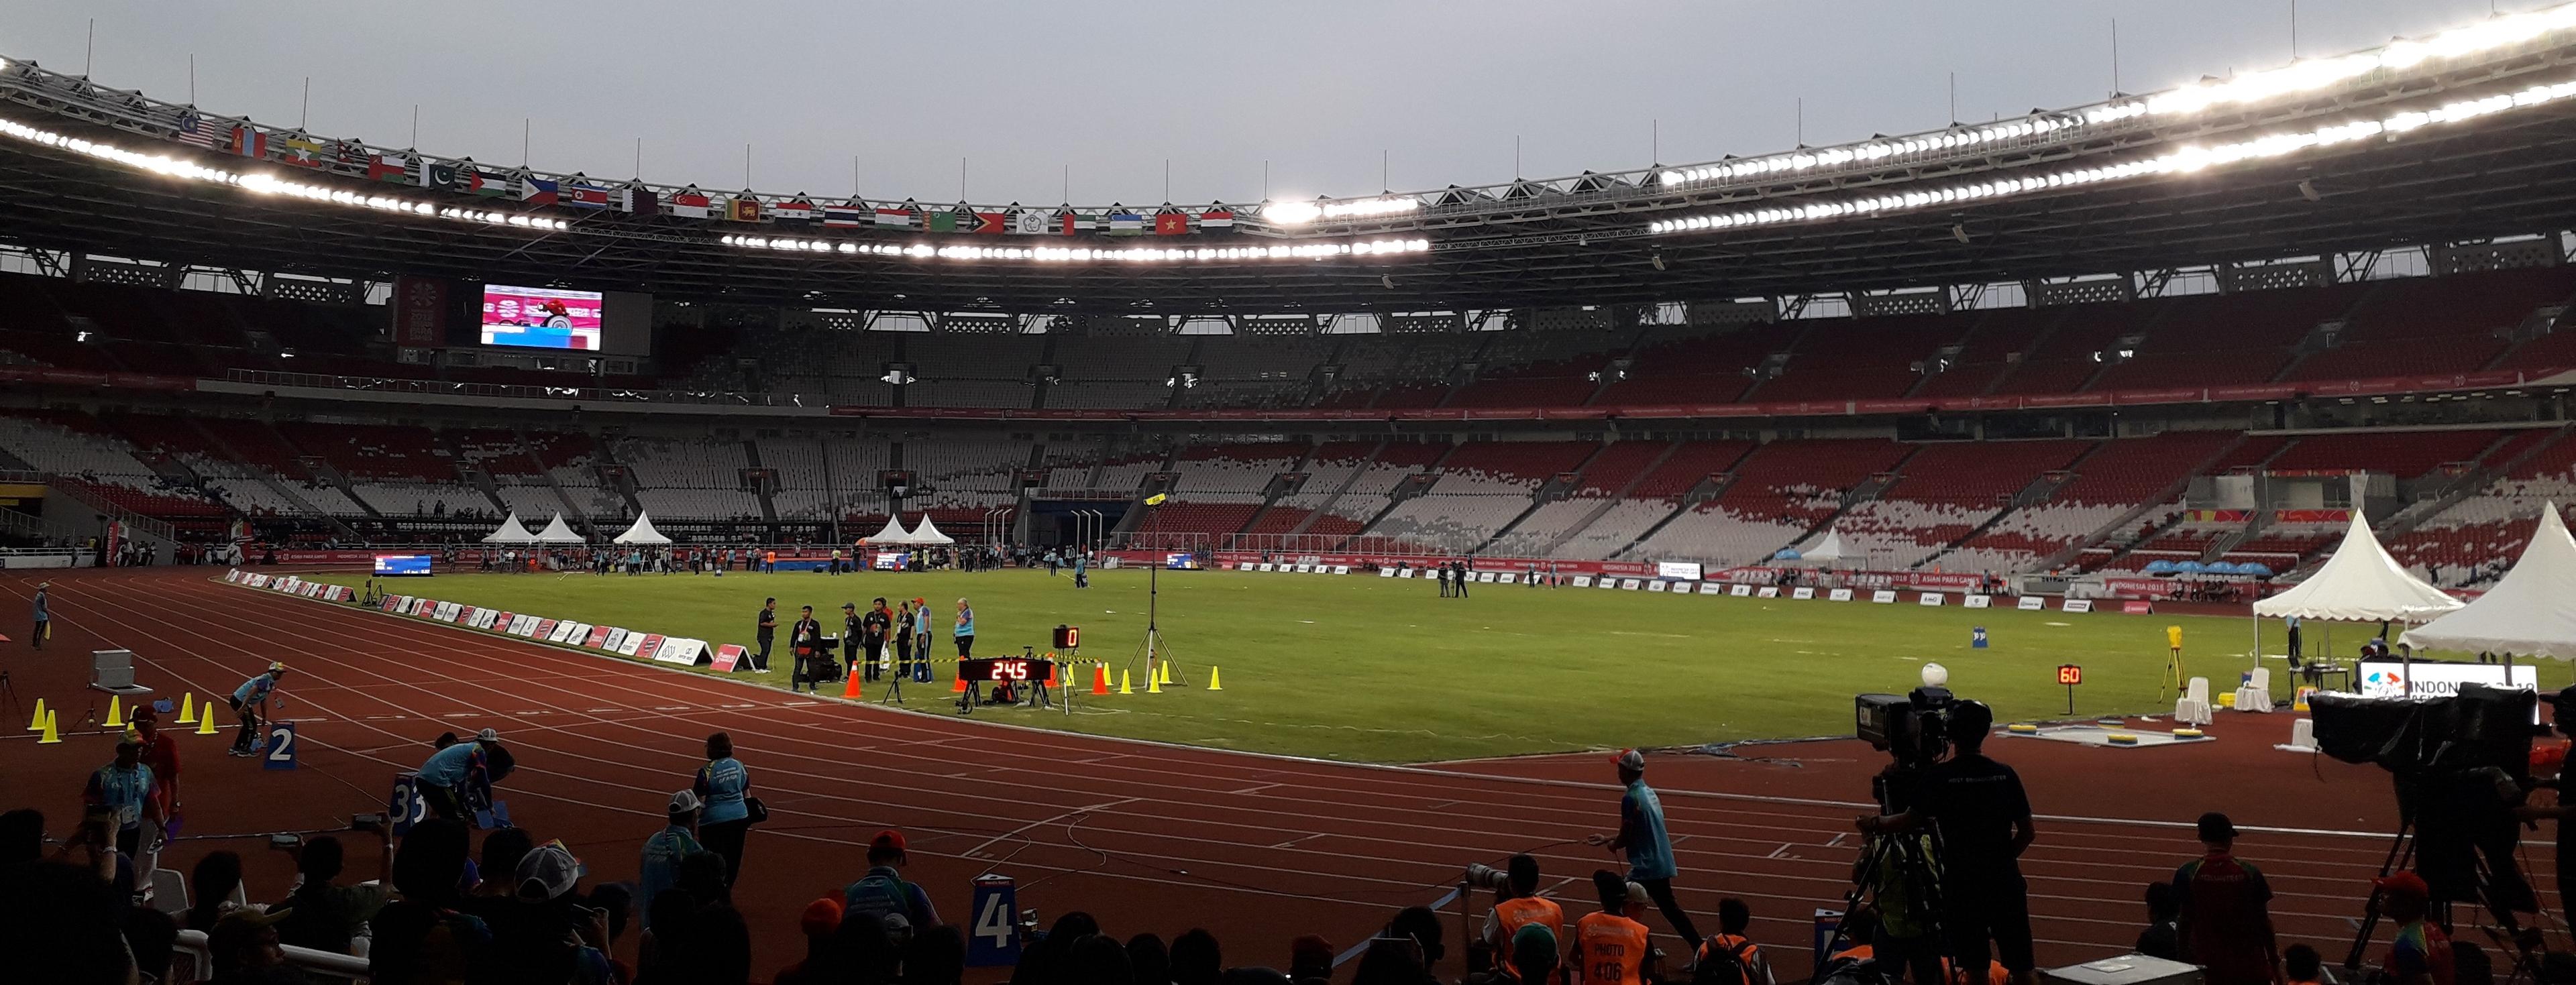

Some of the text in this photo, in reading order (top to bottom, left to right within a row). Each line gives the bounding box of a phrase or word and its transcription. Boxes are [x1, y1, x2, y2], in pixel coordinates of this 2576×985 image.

[2147, 583, 2164, 591] 2018
[1068, 629, 1077, 646] 0
[2060, 667, 2080, 683] 60
[2410, 681, 2459, 694] INDON
[269, 728, 293, 761] 2
[395, 783, 411, 823] 3
[975, 892, 1013, 949] 4
[1594, 943, 1625, 956] PHOTO
[1593, 962, 1622, 982] 406
